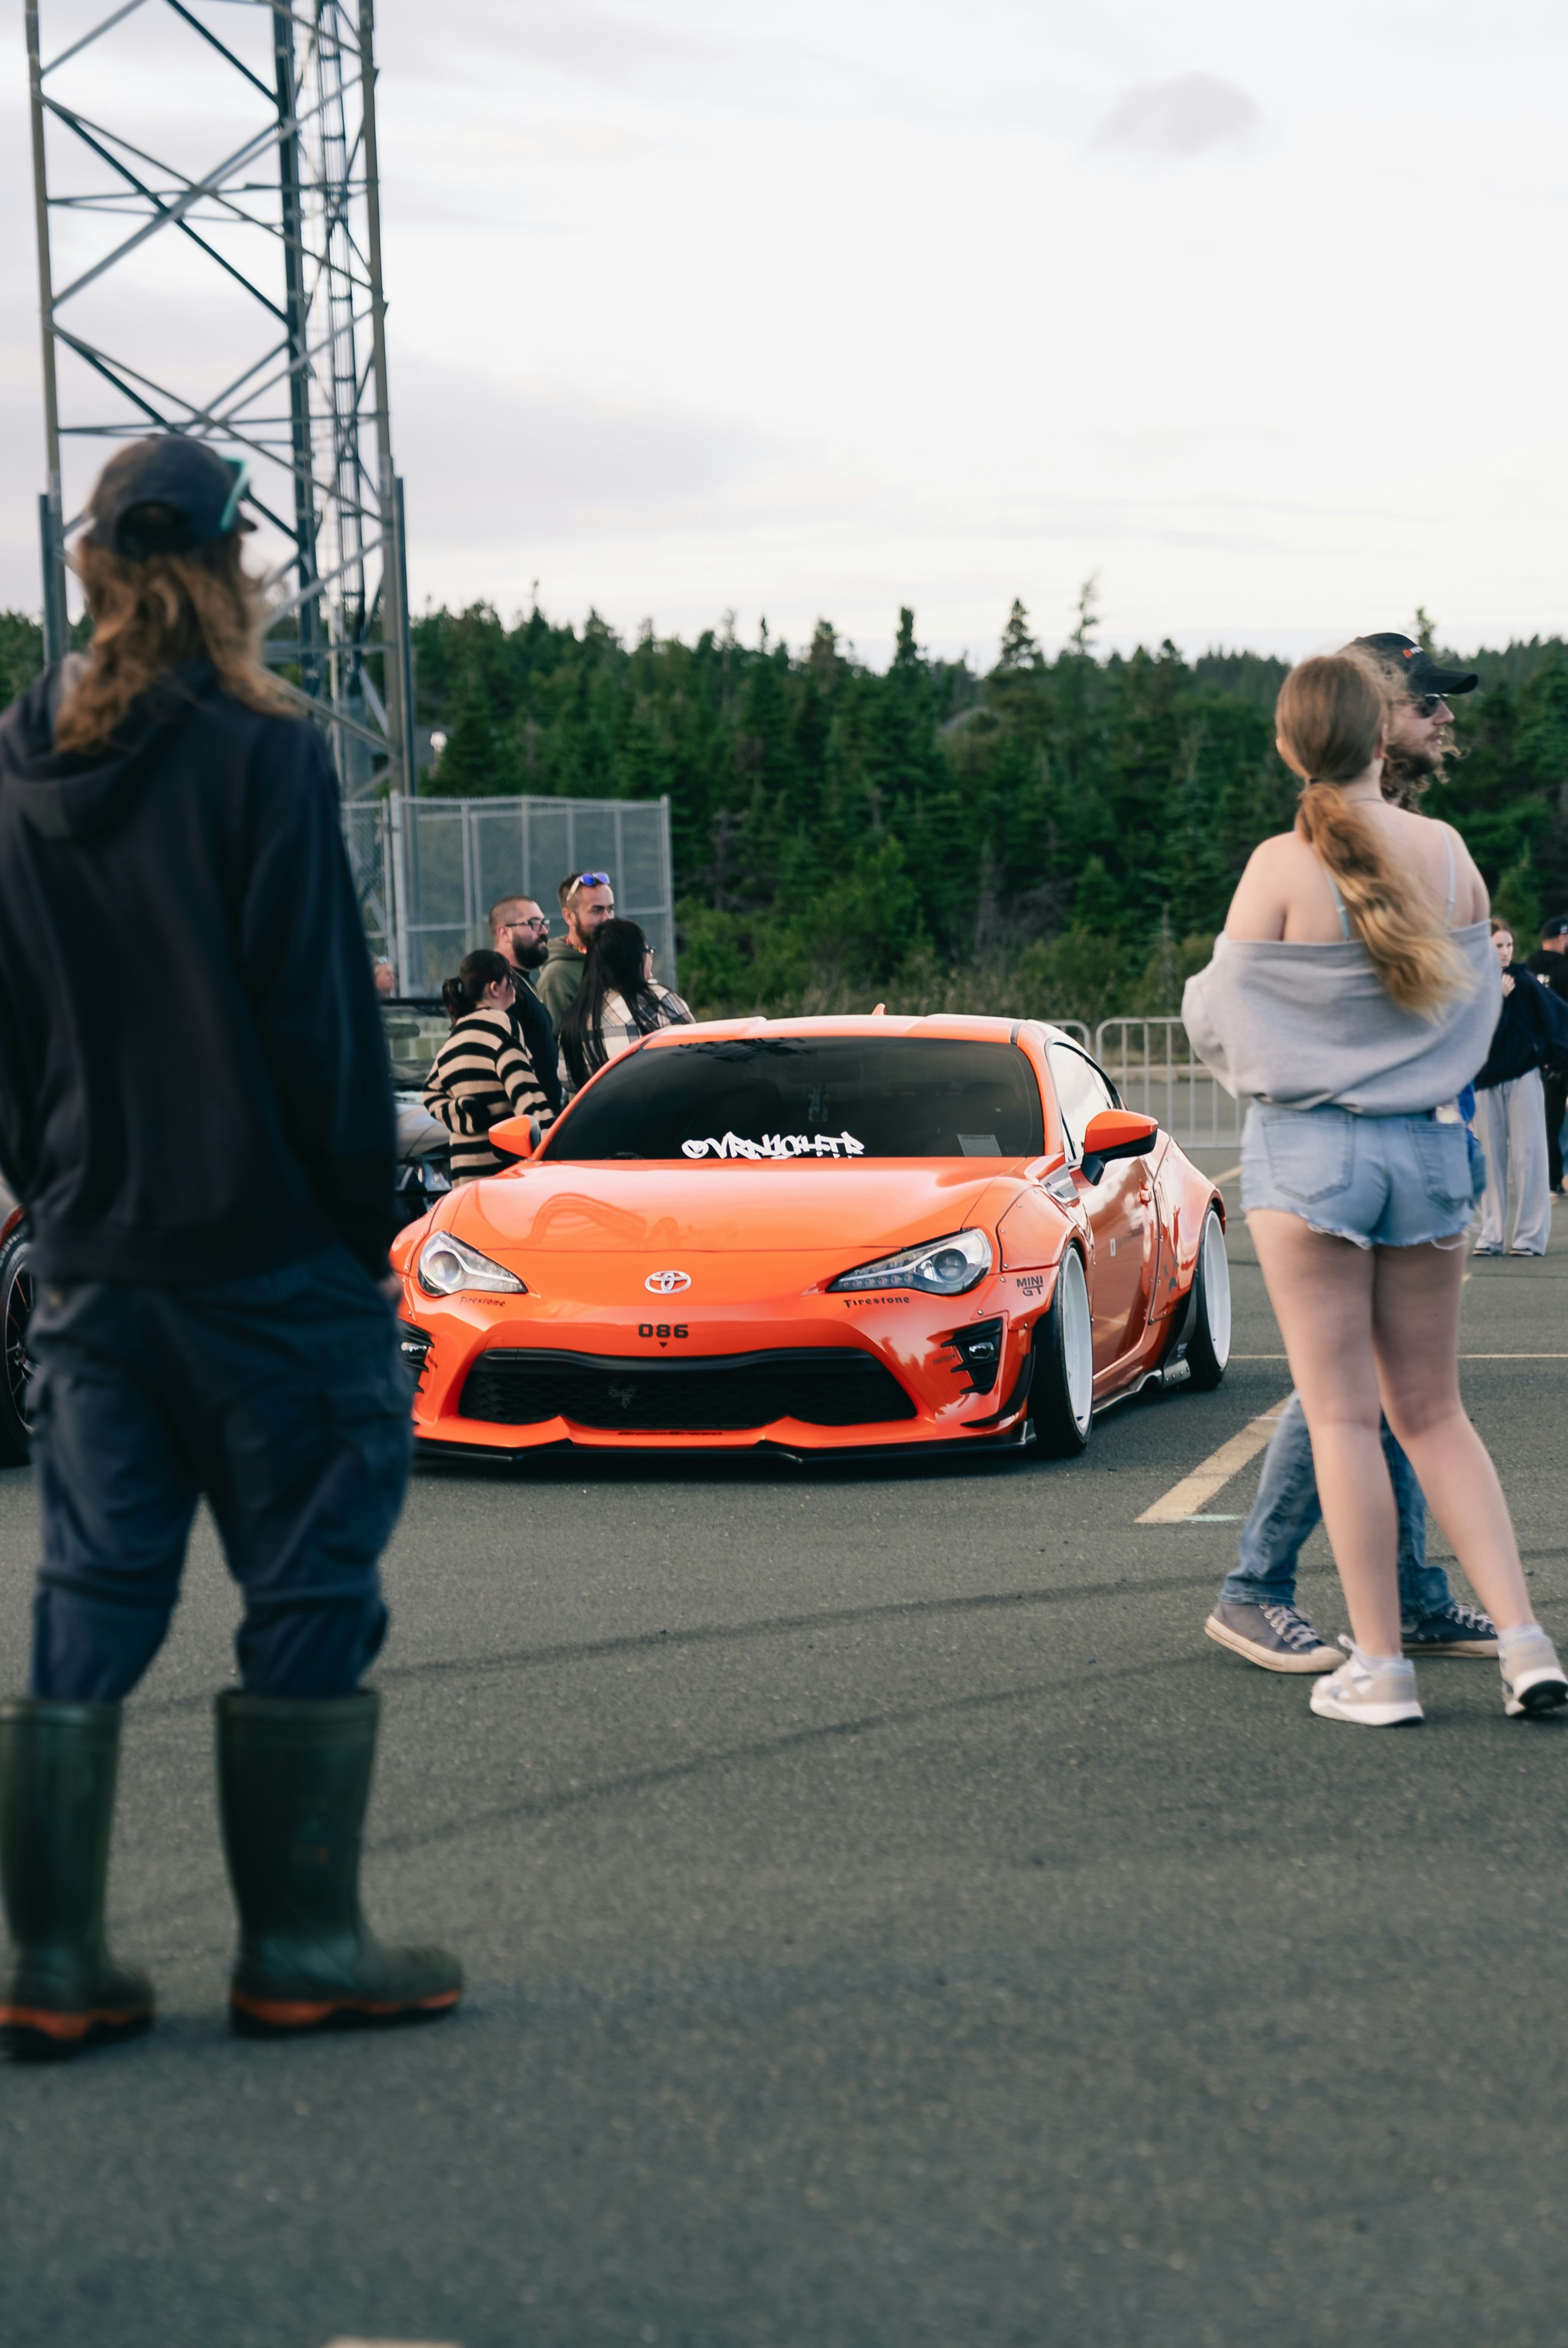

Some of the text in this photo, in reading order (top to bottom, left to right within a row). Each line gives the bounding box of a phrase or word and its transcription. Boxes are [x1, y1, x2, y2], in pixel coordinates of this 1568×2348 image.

[1017, 1275, 1043, 1287] MINI
[1023, 1285, 1043, 1296] GT
[844, 1297, 910, 1308] Firestone
[639, 1324, 689, 1338] 086
